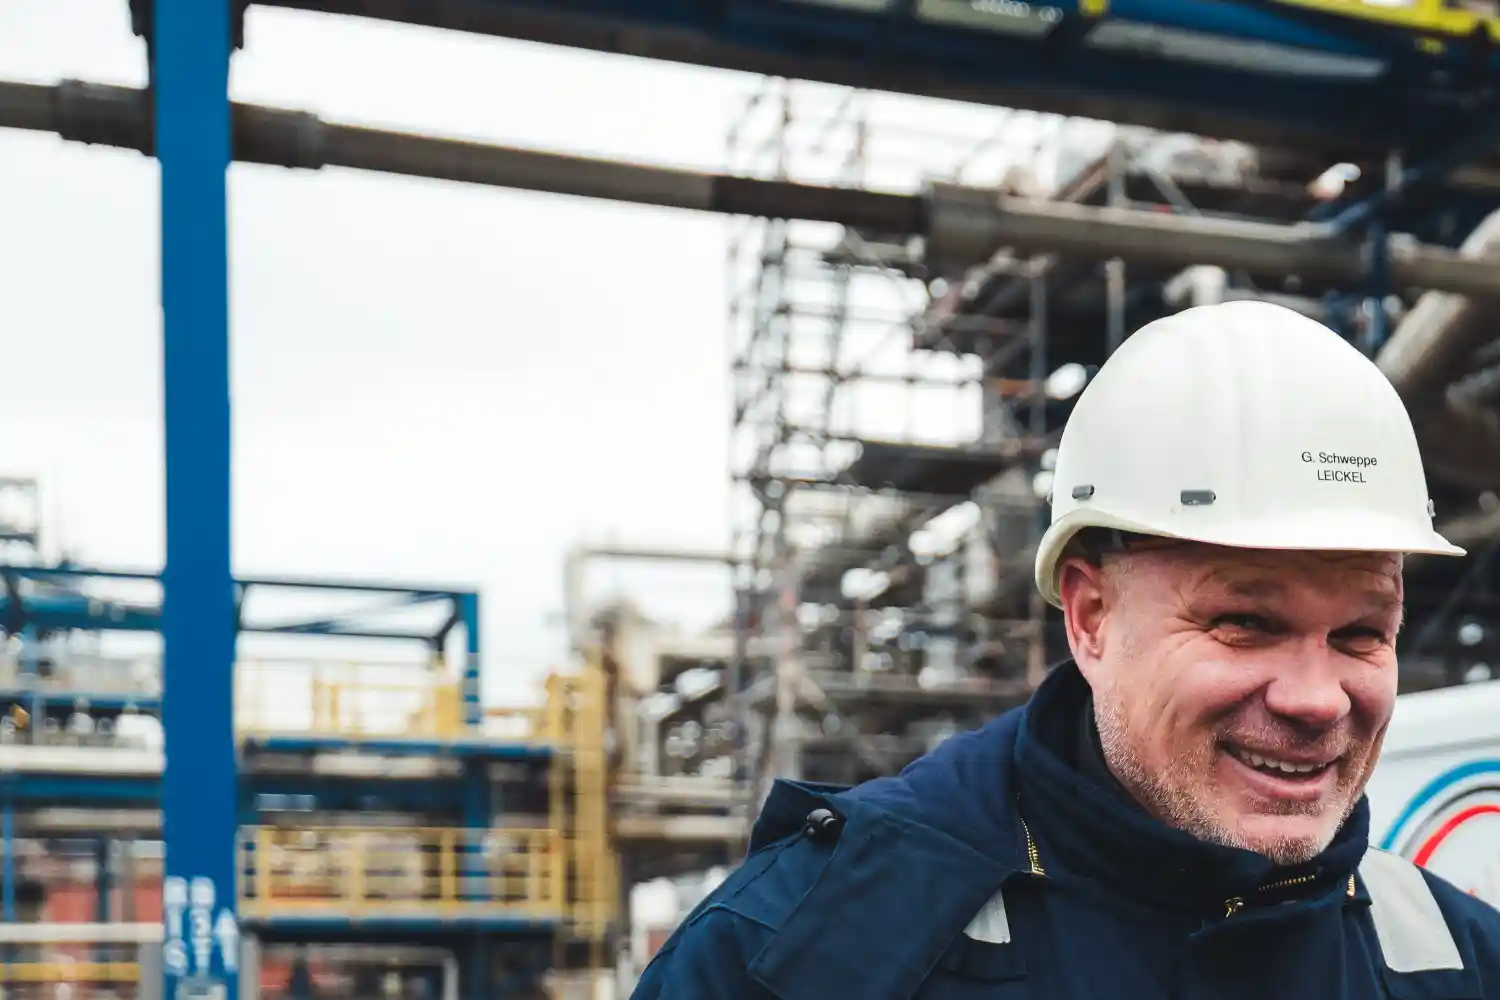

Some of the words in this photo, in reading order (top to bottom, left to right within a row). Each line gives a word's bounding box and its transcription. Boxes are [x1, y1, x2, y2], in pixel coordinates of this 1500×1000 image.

[1301, 451, 1315, 463] G.
[1318, 452, 1377, 468] Schweppe
[1317, 469, 1367, 483] LEICKEL
